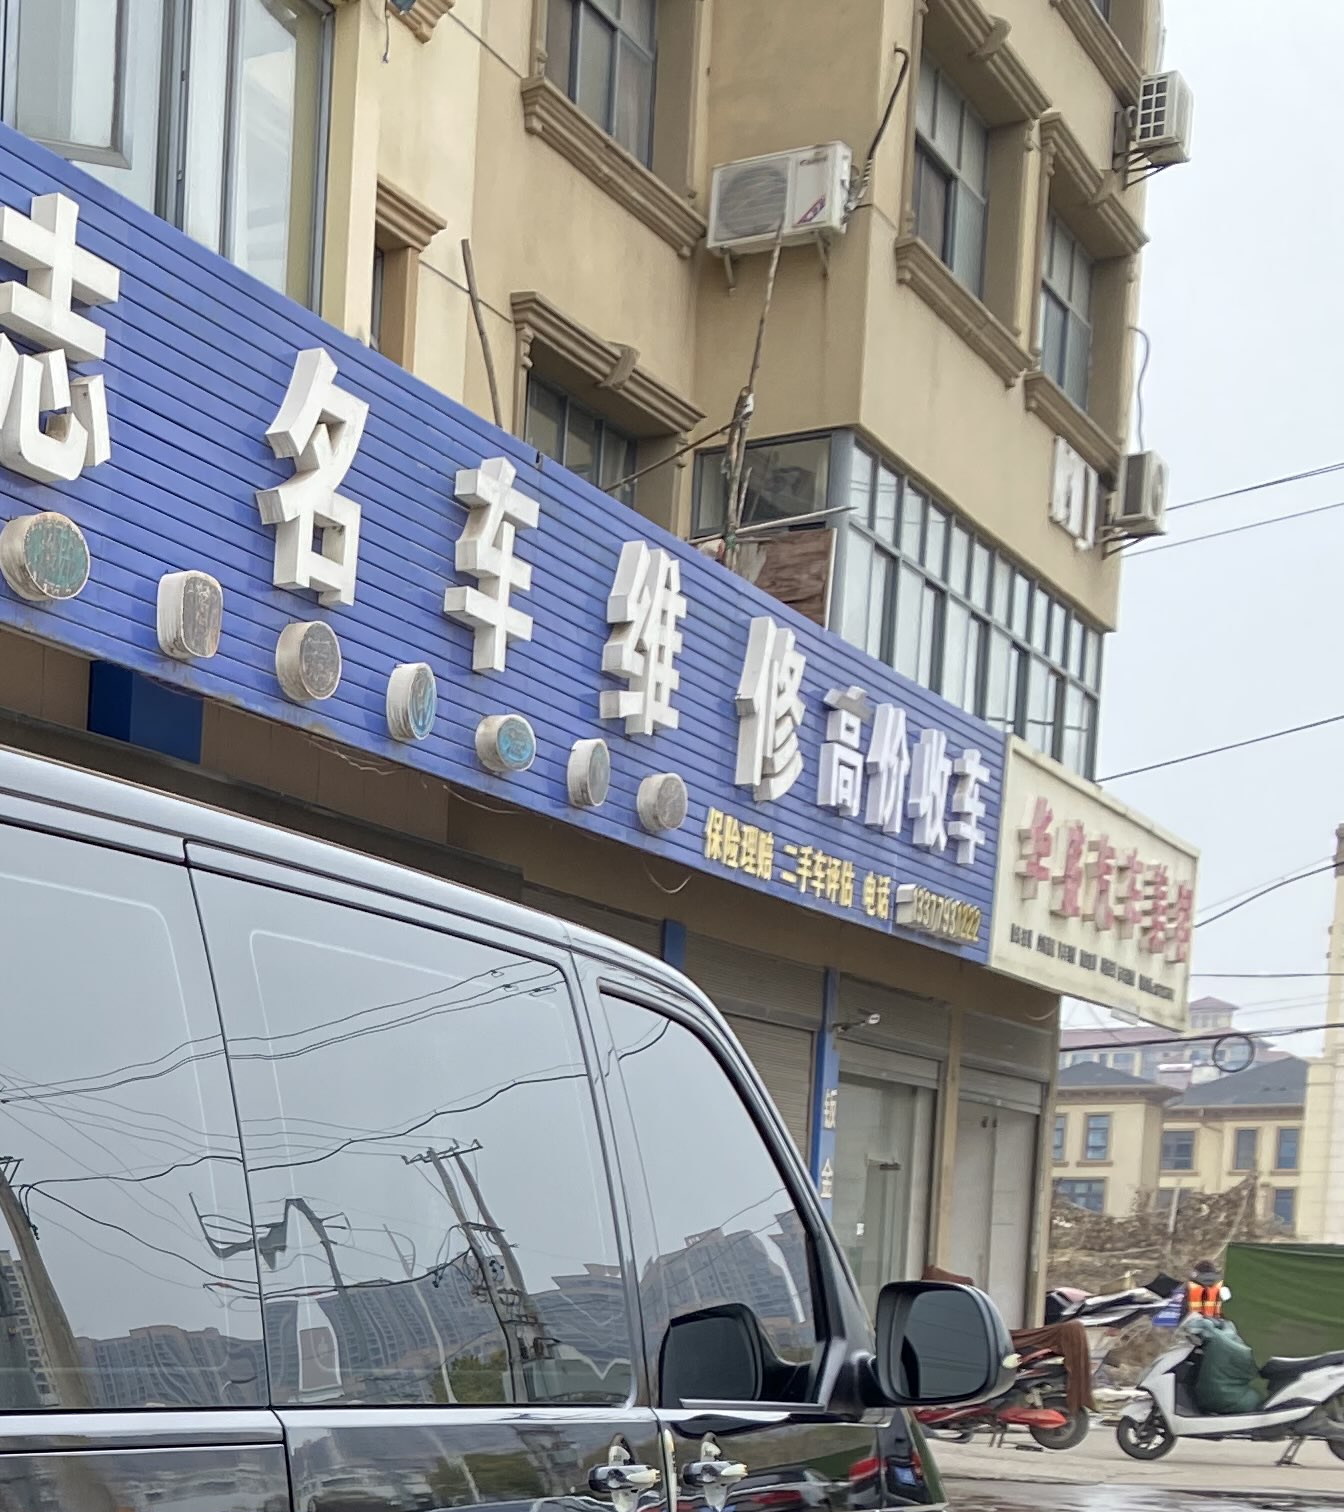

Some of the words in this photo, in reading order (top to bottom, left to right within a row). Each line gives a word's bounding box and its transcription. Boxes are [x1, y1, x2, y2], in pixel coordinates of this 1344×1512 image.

[819, 685, 987, 865] 高价收车
[703, 806, 775, 881] 保险理赔
[779, 844, 855, 909] 二手车评估
[862, 870, 892, 920] 电话
